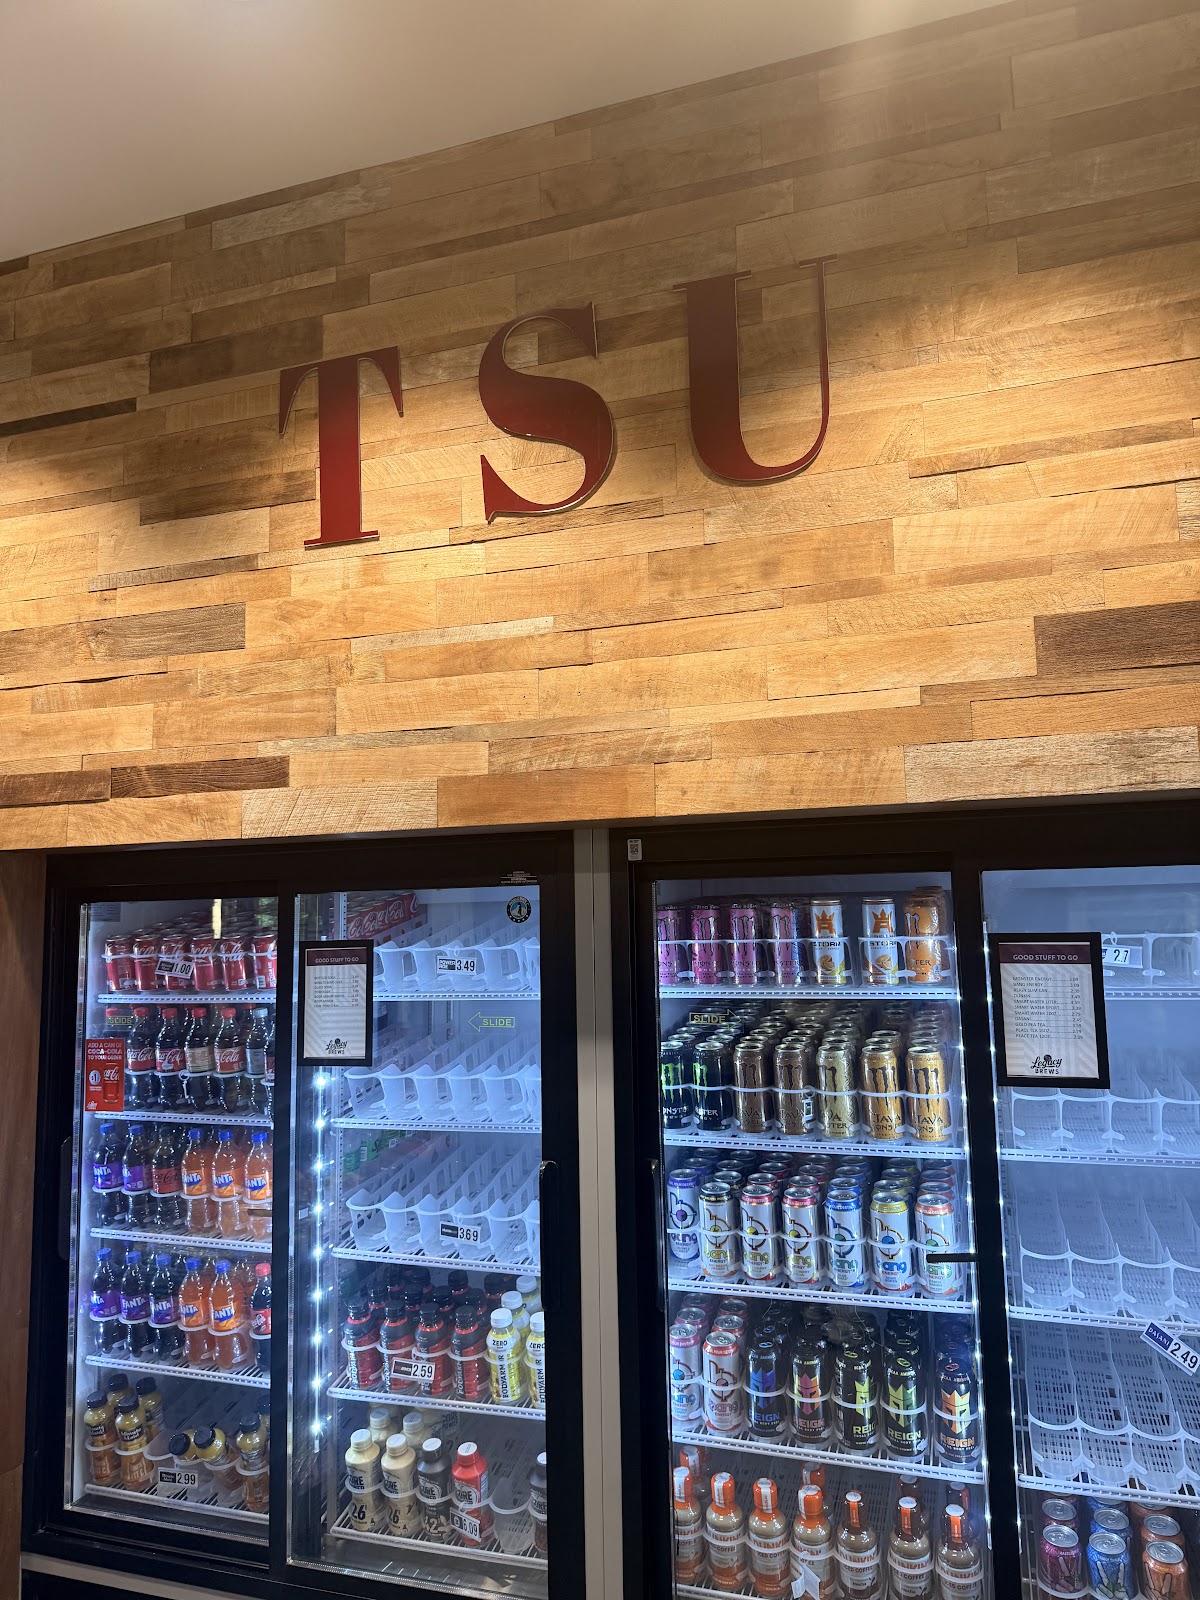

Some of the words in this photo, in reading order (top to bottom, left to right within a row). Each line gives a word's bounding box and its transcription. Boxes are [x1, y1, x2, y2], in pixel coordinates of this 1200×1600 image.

[279, 255, 838, 549] TSU
[174, 962, 191, 975] 1.00
[457, 960, 475, 971] 3.49
[109, 1016, 132, 1025] SLIDE
[482, 1018, 512, 1026] SLIDE
[693, 1013, 726, 1024] SLIDE
[1030, 1056, 1063, 1069] Legacy
[459, 1227, 479, 1241] 3.69
[122, 1296, 146, 1309] FANTA
[492, 1339, 508, 1347] ZERO
[1148, 1327, 1170, 1346] DASANI
[1170, 1342, 1198, 1369] 2.49
[412, 1364, 433, 1379] 2.59
[707, 1401, 738, 1414] bang
[887, 1427, 922, 1441] REIGN
[940, 1433, 975, 1447] REIGN
[177, 1472, 196, 1486] 2.99
[351, 1502, 366, 1520] 26
